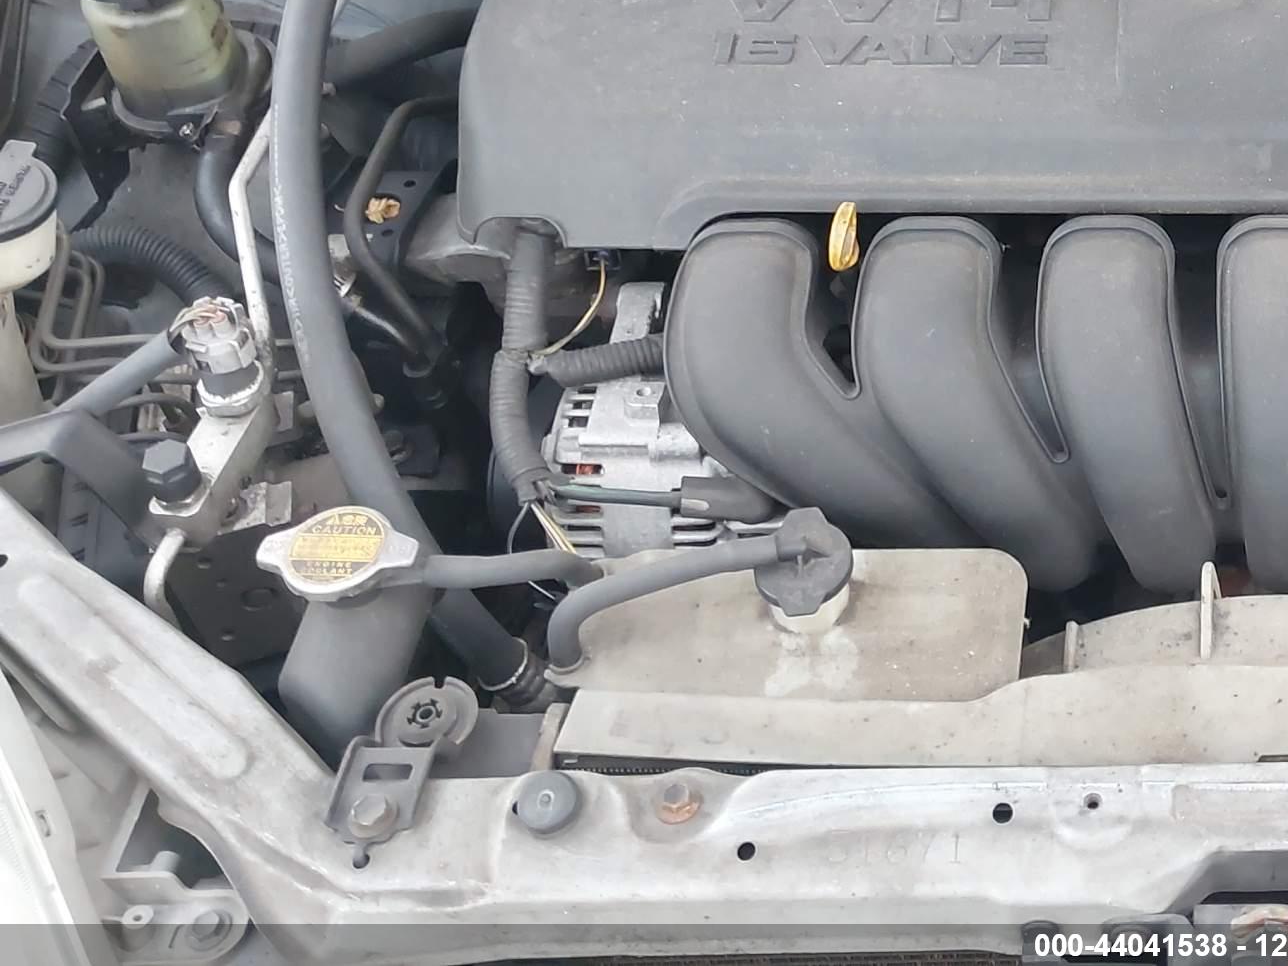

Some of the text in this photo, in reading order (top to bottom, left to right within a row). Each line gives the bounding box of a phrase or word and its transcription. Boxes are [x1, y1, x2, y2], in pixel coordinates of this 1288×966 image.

[713, 33, 1049, 66] 16 VALVE
[312, 525, 377, 535] CAUTION
